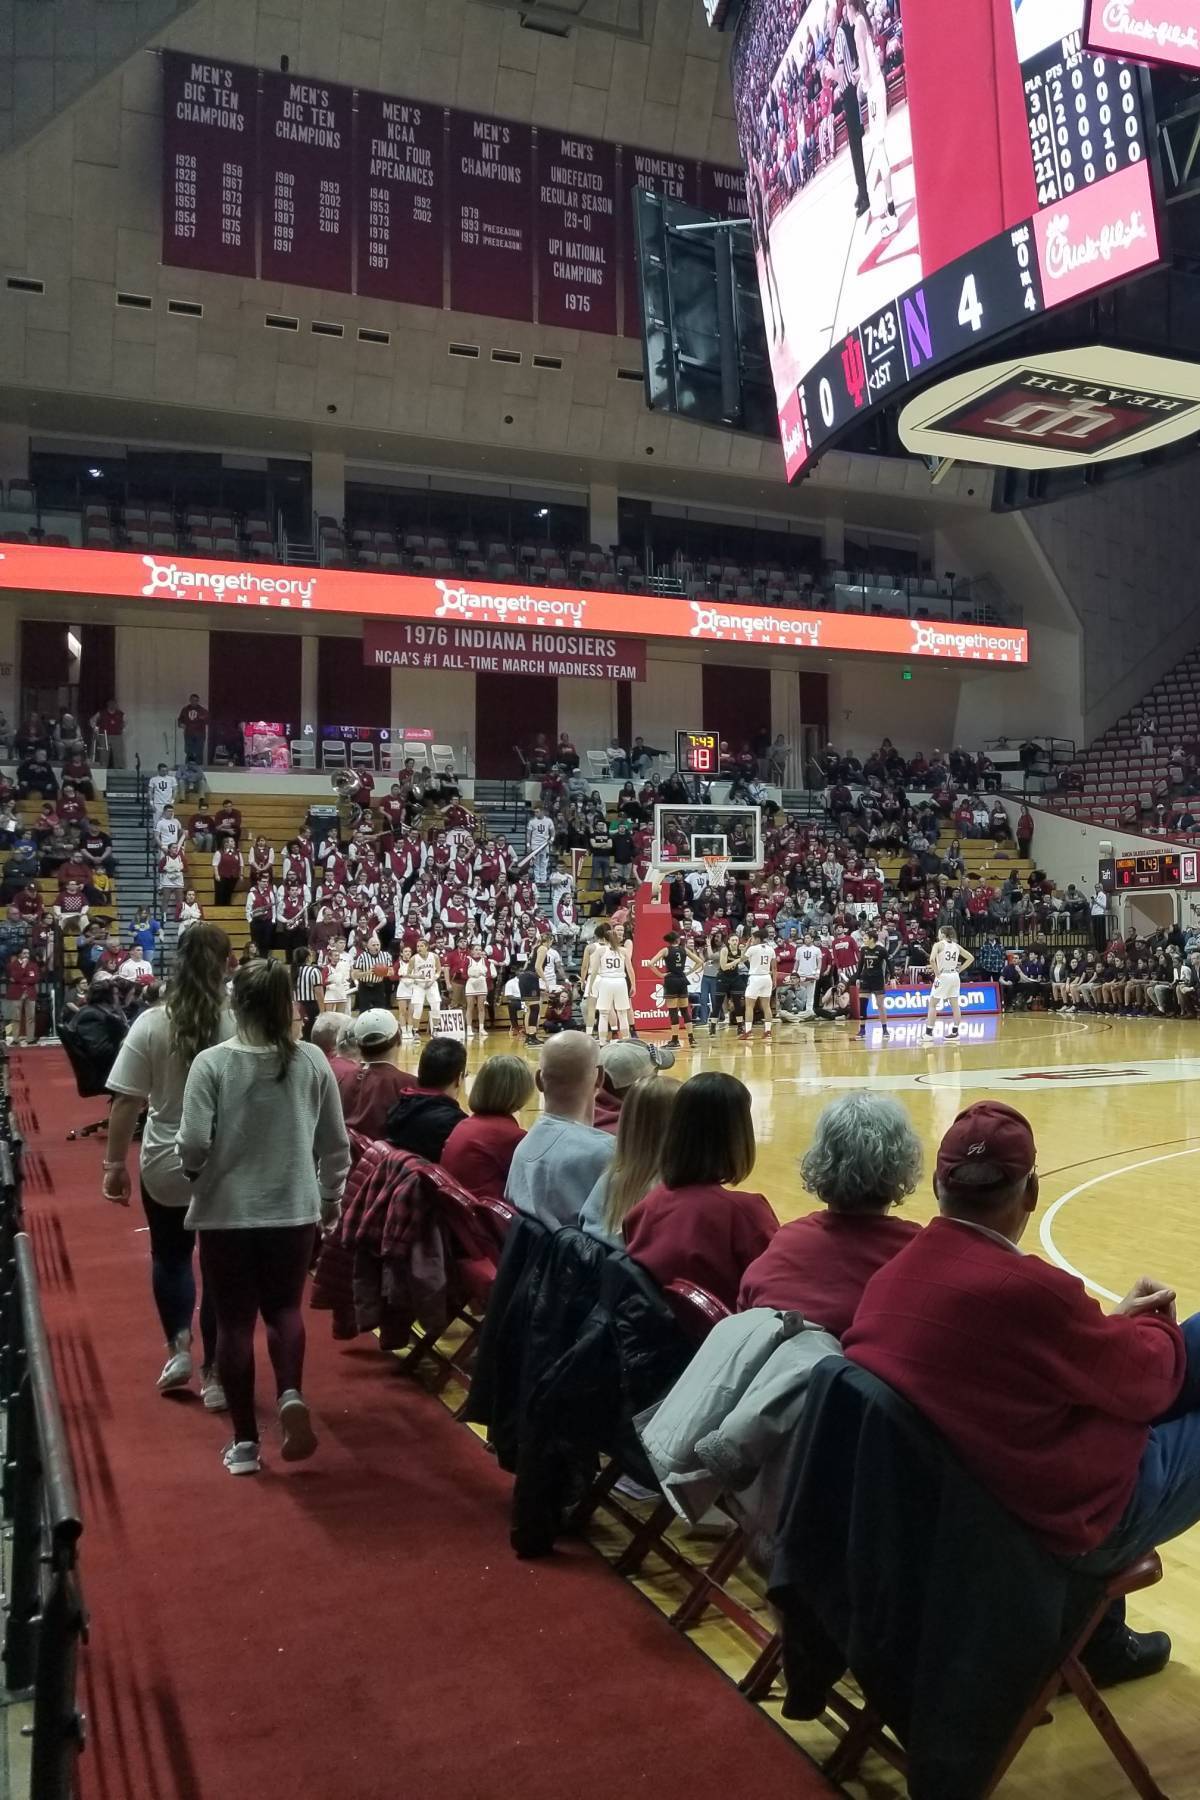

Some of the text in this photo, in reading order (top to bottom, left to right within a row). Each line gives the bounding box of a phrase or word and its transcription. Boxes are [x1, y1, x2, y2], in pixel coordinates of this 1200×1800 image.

[191, 64, 232, 88] MEN'S
[1024, 53, 1083, 94] PLR PTS AST
[184, 82, 238, 110] BIG TEN
[290, 84, 328, 107] MEN'S
[1030, 81, 1063, 113] 3 2
[176, 102, 244, 132] CHAMPIONS
[284, 101, 335, 129] BIG TEN
[383, 102, 421, 125] MEN'S
[1029, 104, 1066, 140] 10 2
[276, 120, 341, 150] CHAMPIONS
[388, 123, 415, 144] NCAA
[473, 121, 510, 144] MEN'S
[372, 139, 432, 166] FINAL FOUR
[482, 142, 500, 161] NIT
[561, 140, 594, 161] MEN'S
[1032, 136, 1050, 160] 12
[370, 158, 434, 187] APPEARANCES
[461, 157, 522, 184] CHAMPIONS
[551, 166, 602, 191] UNDEFEATED
[634, 155, 685, 180] WOMEN'S
[1035, 158, 1054, 183] 21
[541, 187, 612, 214] REGULAR SEASON
[662, 180, 683, 198] TEN
[1038, 182, 1058, 205] 44
[461, 206, 479, 220] 1979
[564, 214, 591, 232] (29-0)
[461, 219, 479, 232] 1993
[461, 232, 479, 246] 1997
[549, 239, 606, 264] UPI NATIONAL
[1017, 244, 1028, 268] 0
[554, 262, 602, 286] CHAMPIONS
[566, 294, 590, 312] 1975
[957, 274, 983, 332] 4
[1024, 287, 1036, 311] 4
[864, 312, 896, 356] 7:43
[904, 288, 932, 368] N
[819, 378, 834, 428] 0
[1021, 376, 1184, 412] HEALTH
[404, 625, 616, 658] 1976 INDIANA HOOSIERS
[375, 650, 636, 679] NCAA'S #1 ALL-TIME MARCH MADNESS TEAM
[688, 736, 714, 748] 7:43
[692, 748, 710, 770] 18
[605, 958, 622, 969] 50
[760, 956, 769, 965] 13
[945, 951, 958, 962] 34
